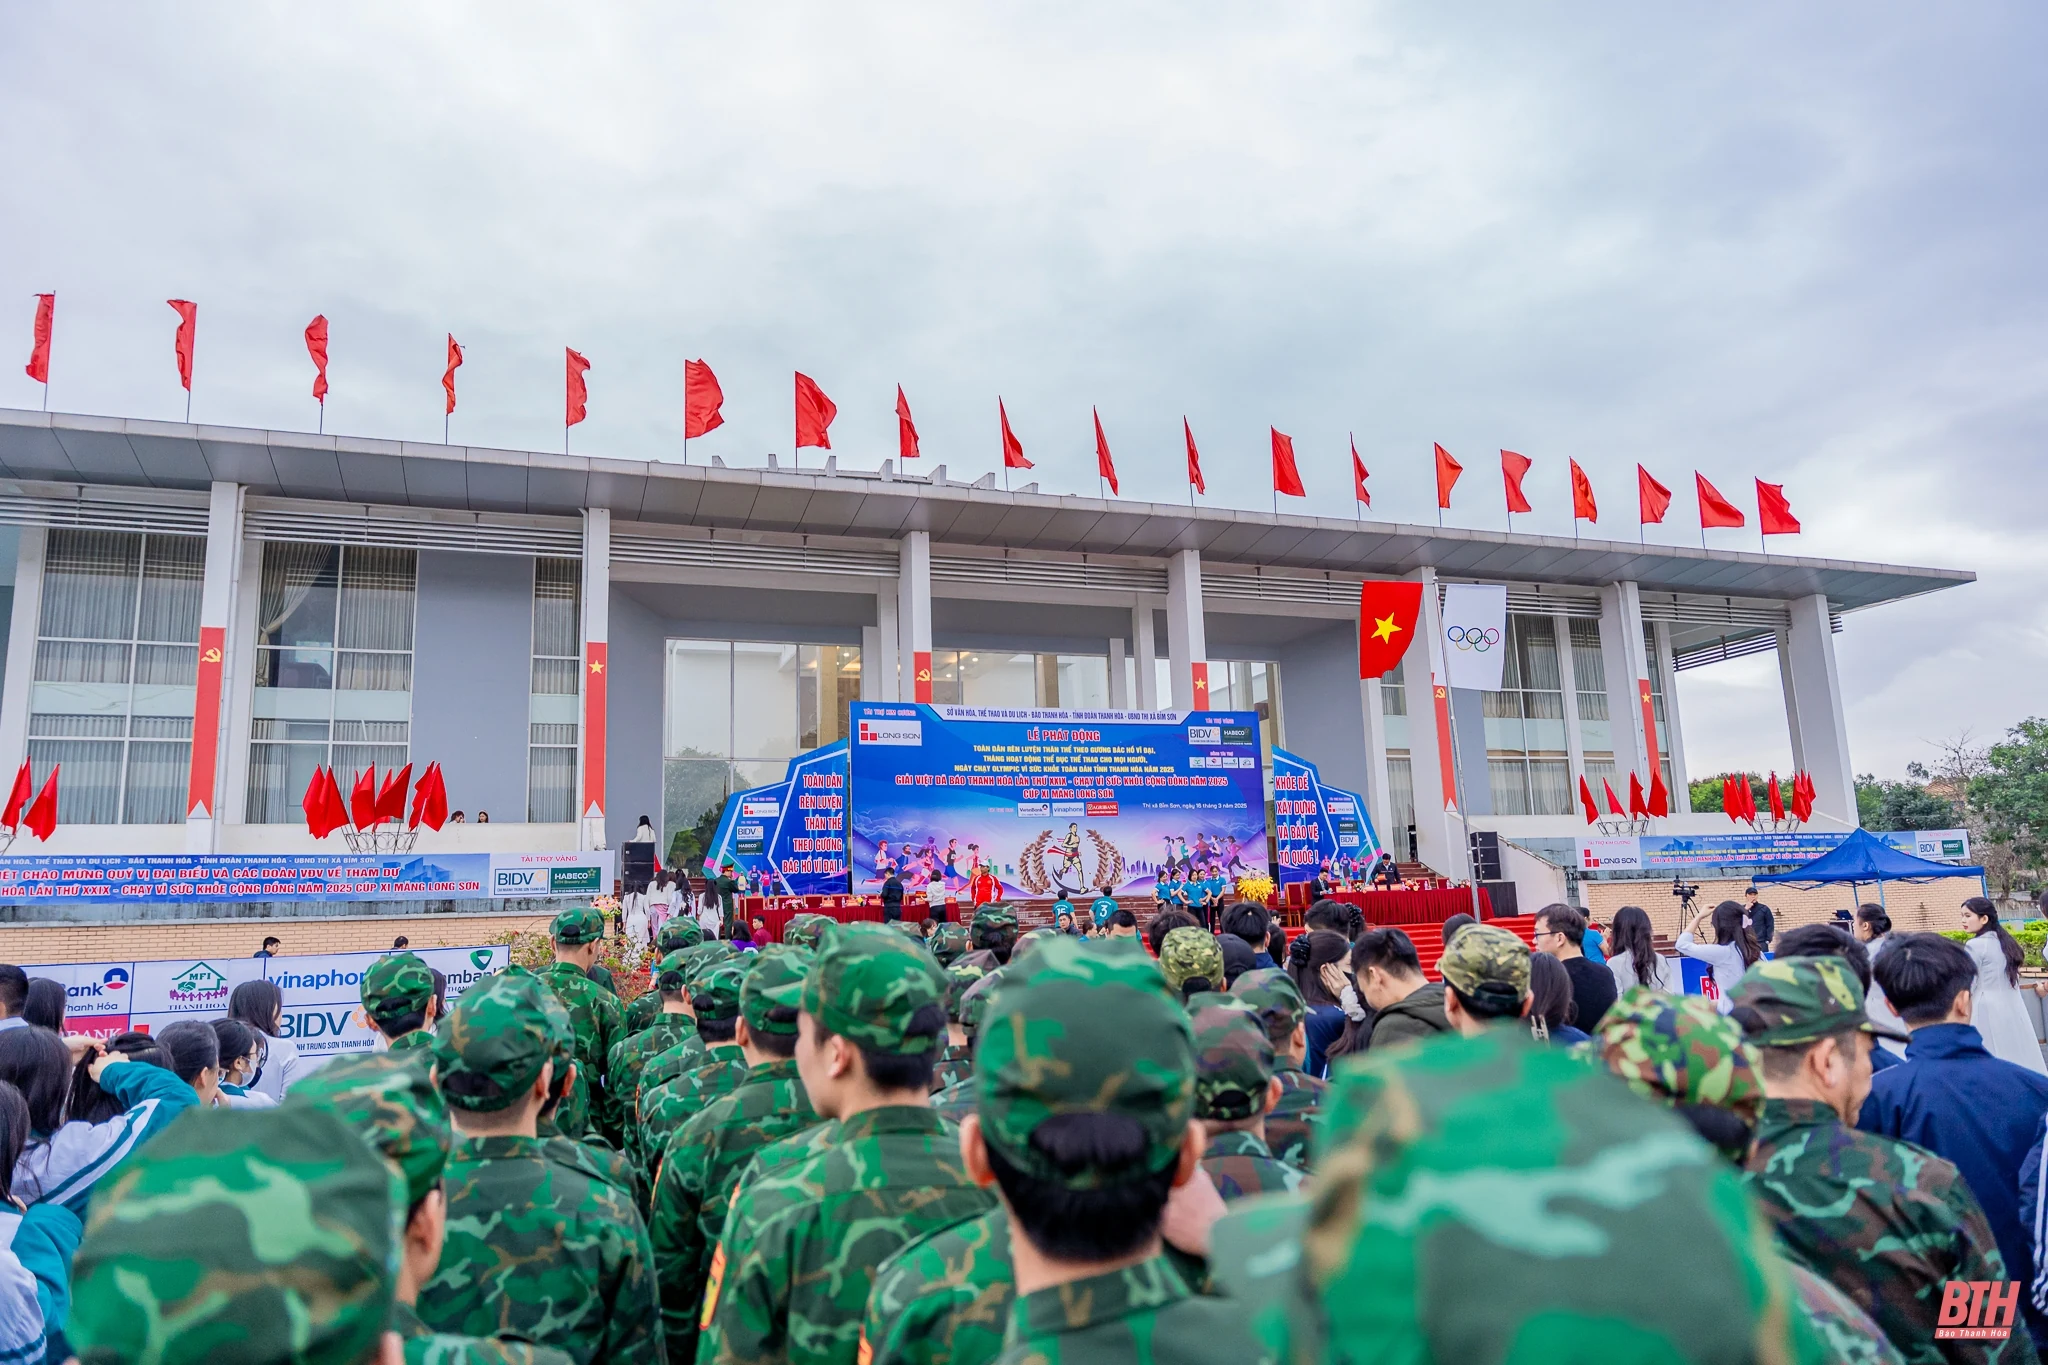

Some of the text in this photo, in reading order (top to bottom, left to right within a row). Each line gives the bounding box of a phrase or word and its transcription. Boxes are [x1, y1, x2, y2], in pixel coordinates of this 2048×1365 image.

[1027, 726, 1101, 744] LỄ PHÁT ĐỘNG
[1190, 729, 1212, 738] BIDV
[803, 772, 843, 788] TOÀN DÂN
[895, 773, 913, 786] GIẢI
[915, 774, 934, 787] VIỆT
[949, 774, 966, 786] BÁO
[968, 776, 995, 786] THANH
[997, 774, 1014, 786] HÓA
[1015, 774, 1030, 786] LẦN
[1031, 774, 1048, 786] THỨ
[1049, 776, 1067, 786] XXIX
[1074, 776, 1094, 788] CHẠY
[1096, 774, 1105, 787] VÌ
[1106, 774, 1122, 787] SỨC
[1124, 774, 1145, 787] KHỎE
[1145, 775, 1167, 788] CỘNG
[1168, 774, 1189, 787] ĐỒNG
[1190, 775, 1207, 787] NĂM
[1208, 776, 1229, 787] 2025
[1276, 772, 1296, 791] KHỎE
[1023, 788, 1115, 799] CÚP XI MĂNG LONG SƠN
[800, 793, 843, 812] RÈN LUYỆN
[1276, 800, 1317, 818] XÂY DỰNG
[805, 812, 843, 830] THÂN THỂ
[1278, 821, 1319, 842] VÀ BẢO VỆ
[793, 838, 842, 852] THEO GƯƠNG
[1920, 843, 1936, 853] BIDV
[35, 857, 50, 865] THỂ
[102, 858, 120, 866] LỊCH
[200, 856, 218, 864] TỈNH
[1279, 845, 1314, 866] TỔ QUỐC
[22, 868, 59, 880] CHÀO
[62, 868, 103, 880] MỪNG
[107, 868, 134, 880] QUÝ
[137, 869, 150, 881] VỊ
[153, 868, 176, 881] ĐẠI
[179, 865, 209, 879] BIỂU
[212, 867, 229, 879] VÀ
[232, 867, 259, 878] CÁC
[262, 867, 297, 879] ĐOÀN
[300, 868, 324, 878] VĐV
[327, 866, 342, 878] VỀ
[346, 868, 380, 877] THAM
[382, 867, 401, 879] DỰ
[782, 856, 837, 876] BÁC HỒ VĨ ĐẠI
[498, 873, 534, 886] BIDV
[1, 881, 480, 897] HÓA LẦN THỨ XXIX CHẠY VÌ SỨC KHỎE CỘNG ĐỒNG NĂM 2025 CÚP XI MĂNG LONG SƠN
[1100, 905, 1108, 917] 3
[97, 1002, 118, 1011] Hóa
[280, 1011, 352, 1038] BIDV
[307, 1042, 326, 1050] TRUNG
[327, 1041, 340, 1049] SƠN
[341, 1040, 361, 1048] THANH
[362, 1038, 375, 1046] HÓA
